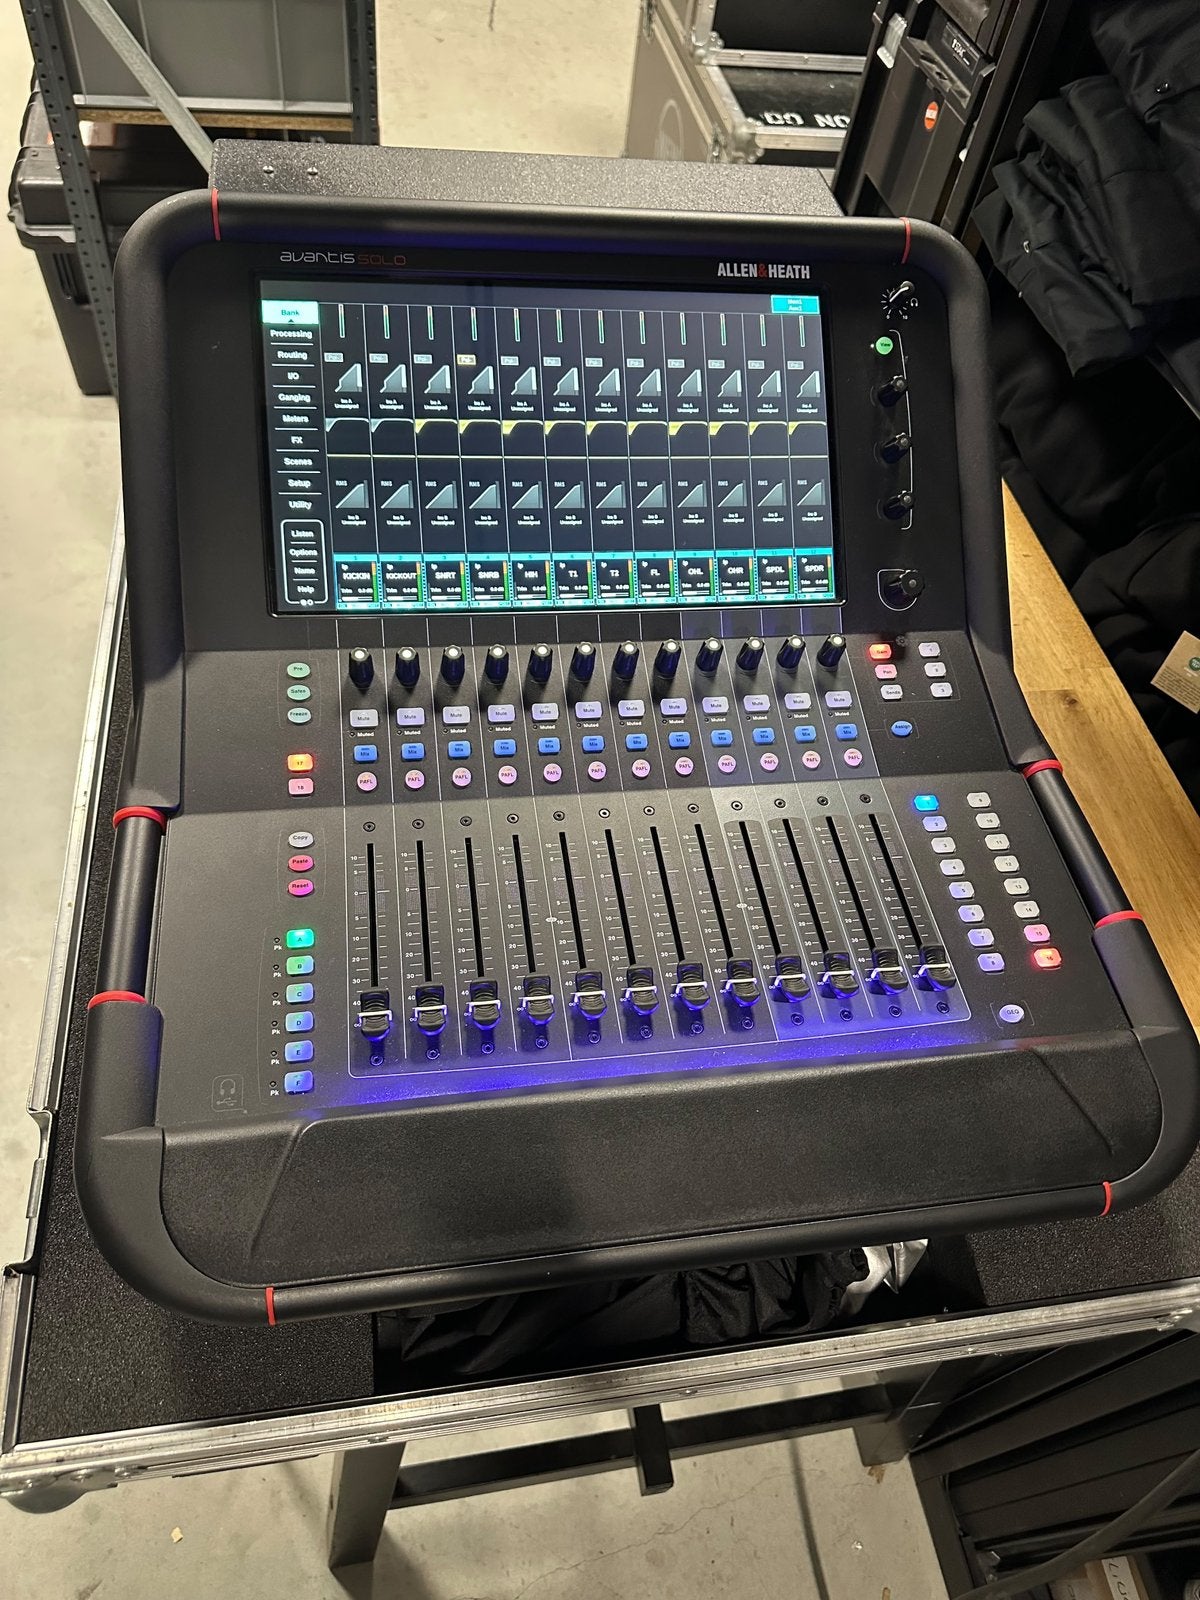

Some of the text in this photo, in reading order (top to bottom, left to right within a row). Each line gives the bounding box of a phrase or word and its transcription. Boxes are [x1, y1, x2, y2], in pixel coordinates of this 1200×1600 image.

[717, 262, 810, 279] ALLEN&HEATH
[270, 329, 312, 339] Processing
[278, 351, 307, 360] Routing
[278, 393, 310, 402] Ganging
[284, 458, 312, 466] Scenes
[288, 479, 311, 488] Setup
[289, 501, 312, 510] Utility
